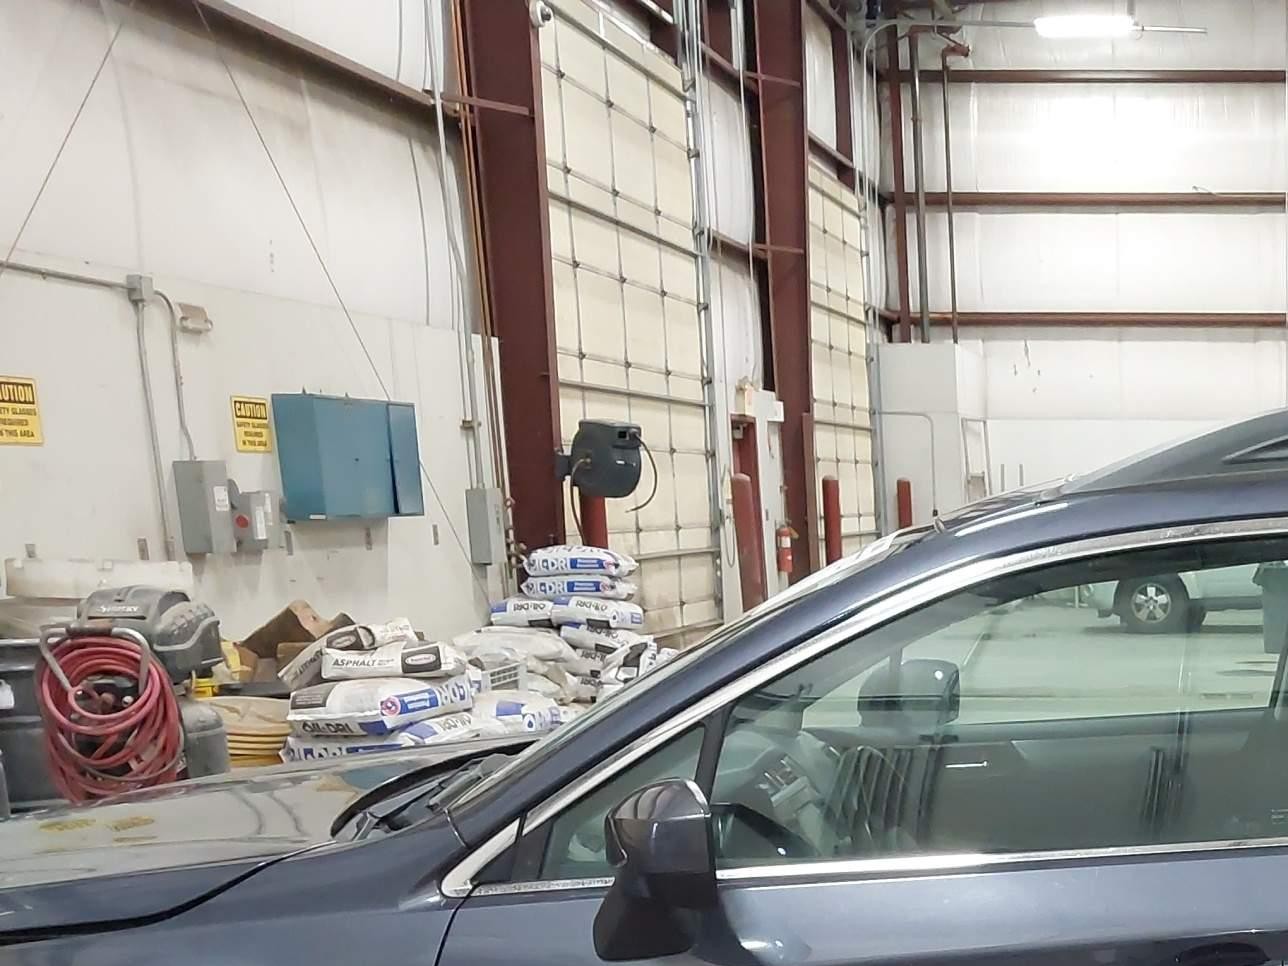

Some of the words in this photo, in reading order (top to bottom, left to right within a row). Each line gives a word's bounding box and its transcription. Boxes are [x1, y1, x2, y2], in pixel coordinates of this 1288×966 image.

[0, 384, 33, 401] UTION
[235, 401, 266, 418] CAUTION
[332, 657, 377, 667] ASPHALT
